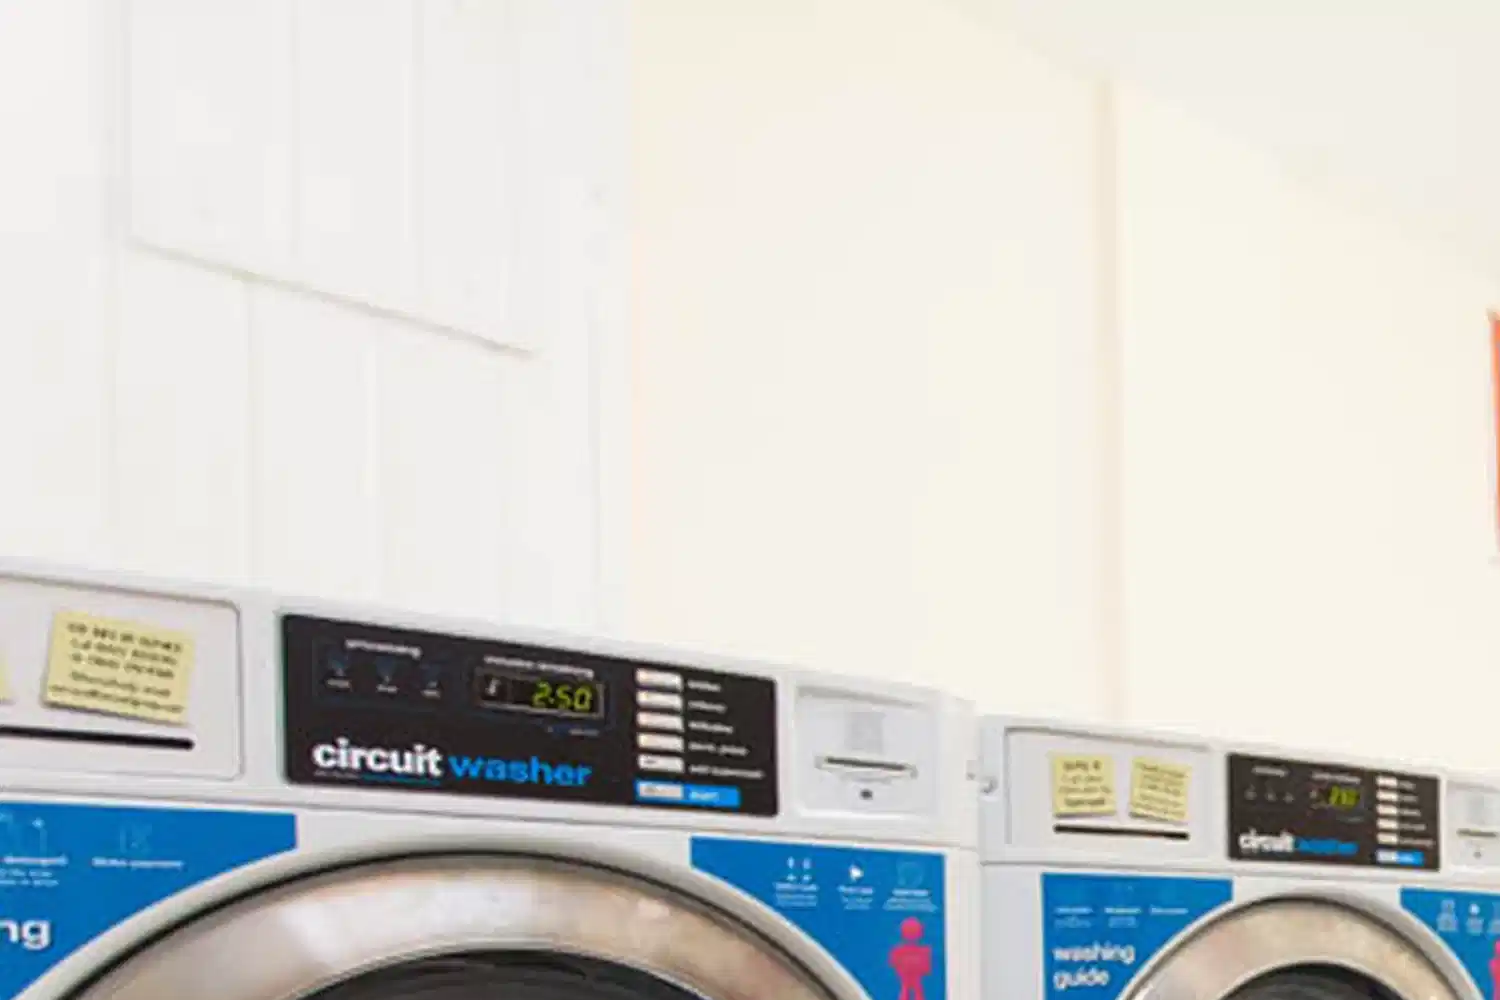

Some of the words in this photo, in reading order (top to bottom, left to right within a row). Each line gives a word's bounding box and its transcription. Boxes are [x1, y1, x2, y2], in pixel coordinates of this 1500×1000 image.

[312, 737, 443, 776] circuit
[448, 755, 592, 786] washer
[1053, 940, 1135, 966] washing
[1053, 966, 1109, 991] guide
